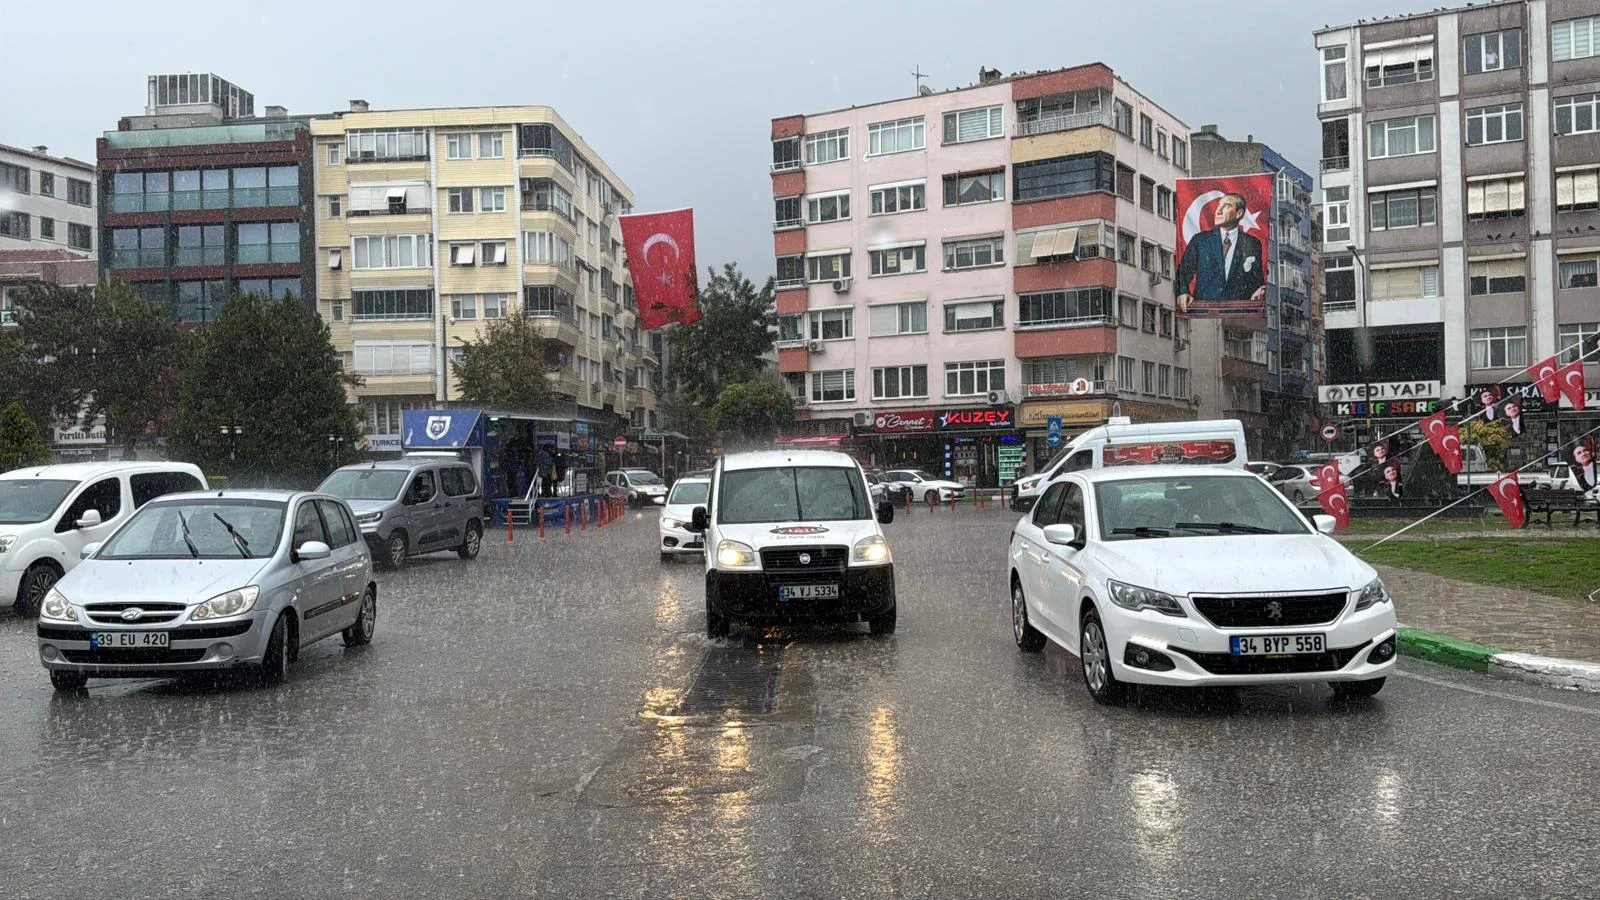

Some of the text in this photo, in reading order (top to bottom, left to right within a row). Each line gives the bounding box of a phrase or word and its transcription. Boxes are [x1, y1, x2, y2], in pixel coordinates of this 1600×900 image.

[1391, 383, 1432, 395] YAPI
[948, 410, 1010, 424] KUZEY
[785, 587, 796, 597] 34
[815, 586, 836, 596] 5334
[98, 633, 167, 646] 39 EU 420
[1240, 635, 1323, 654] 34 BYP 558
